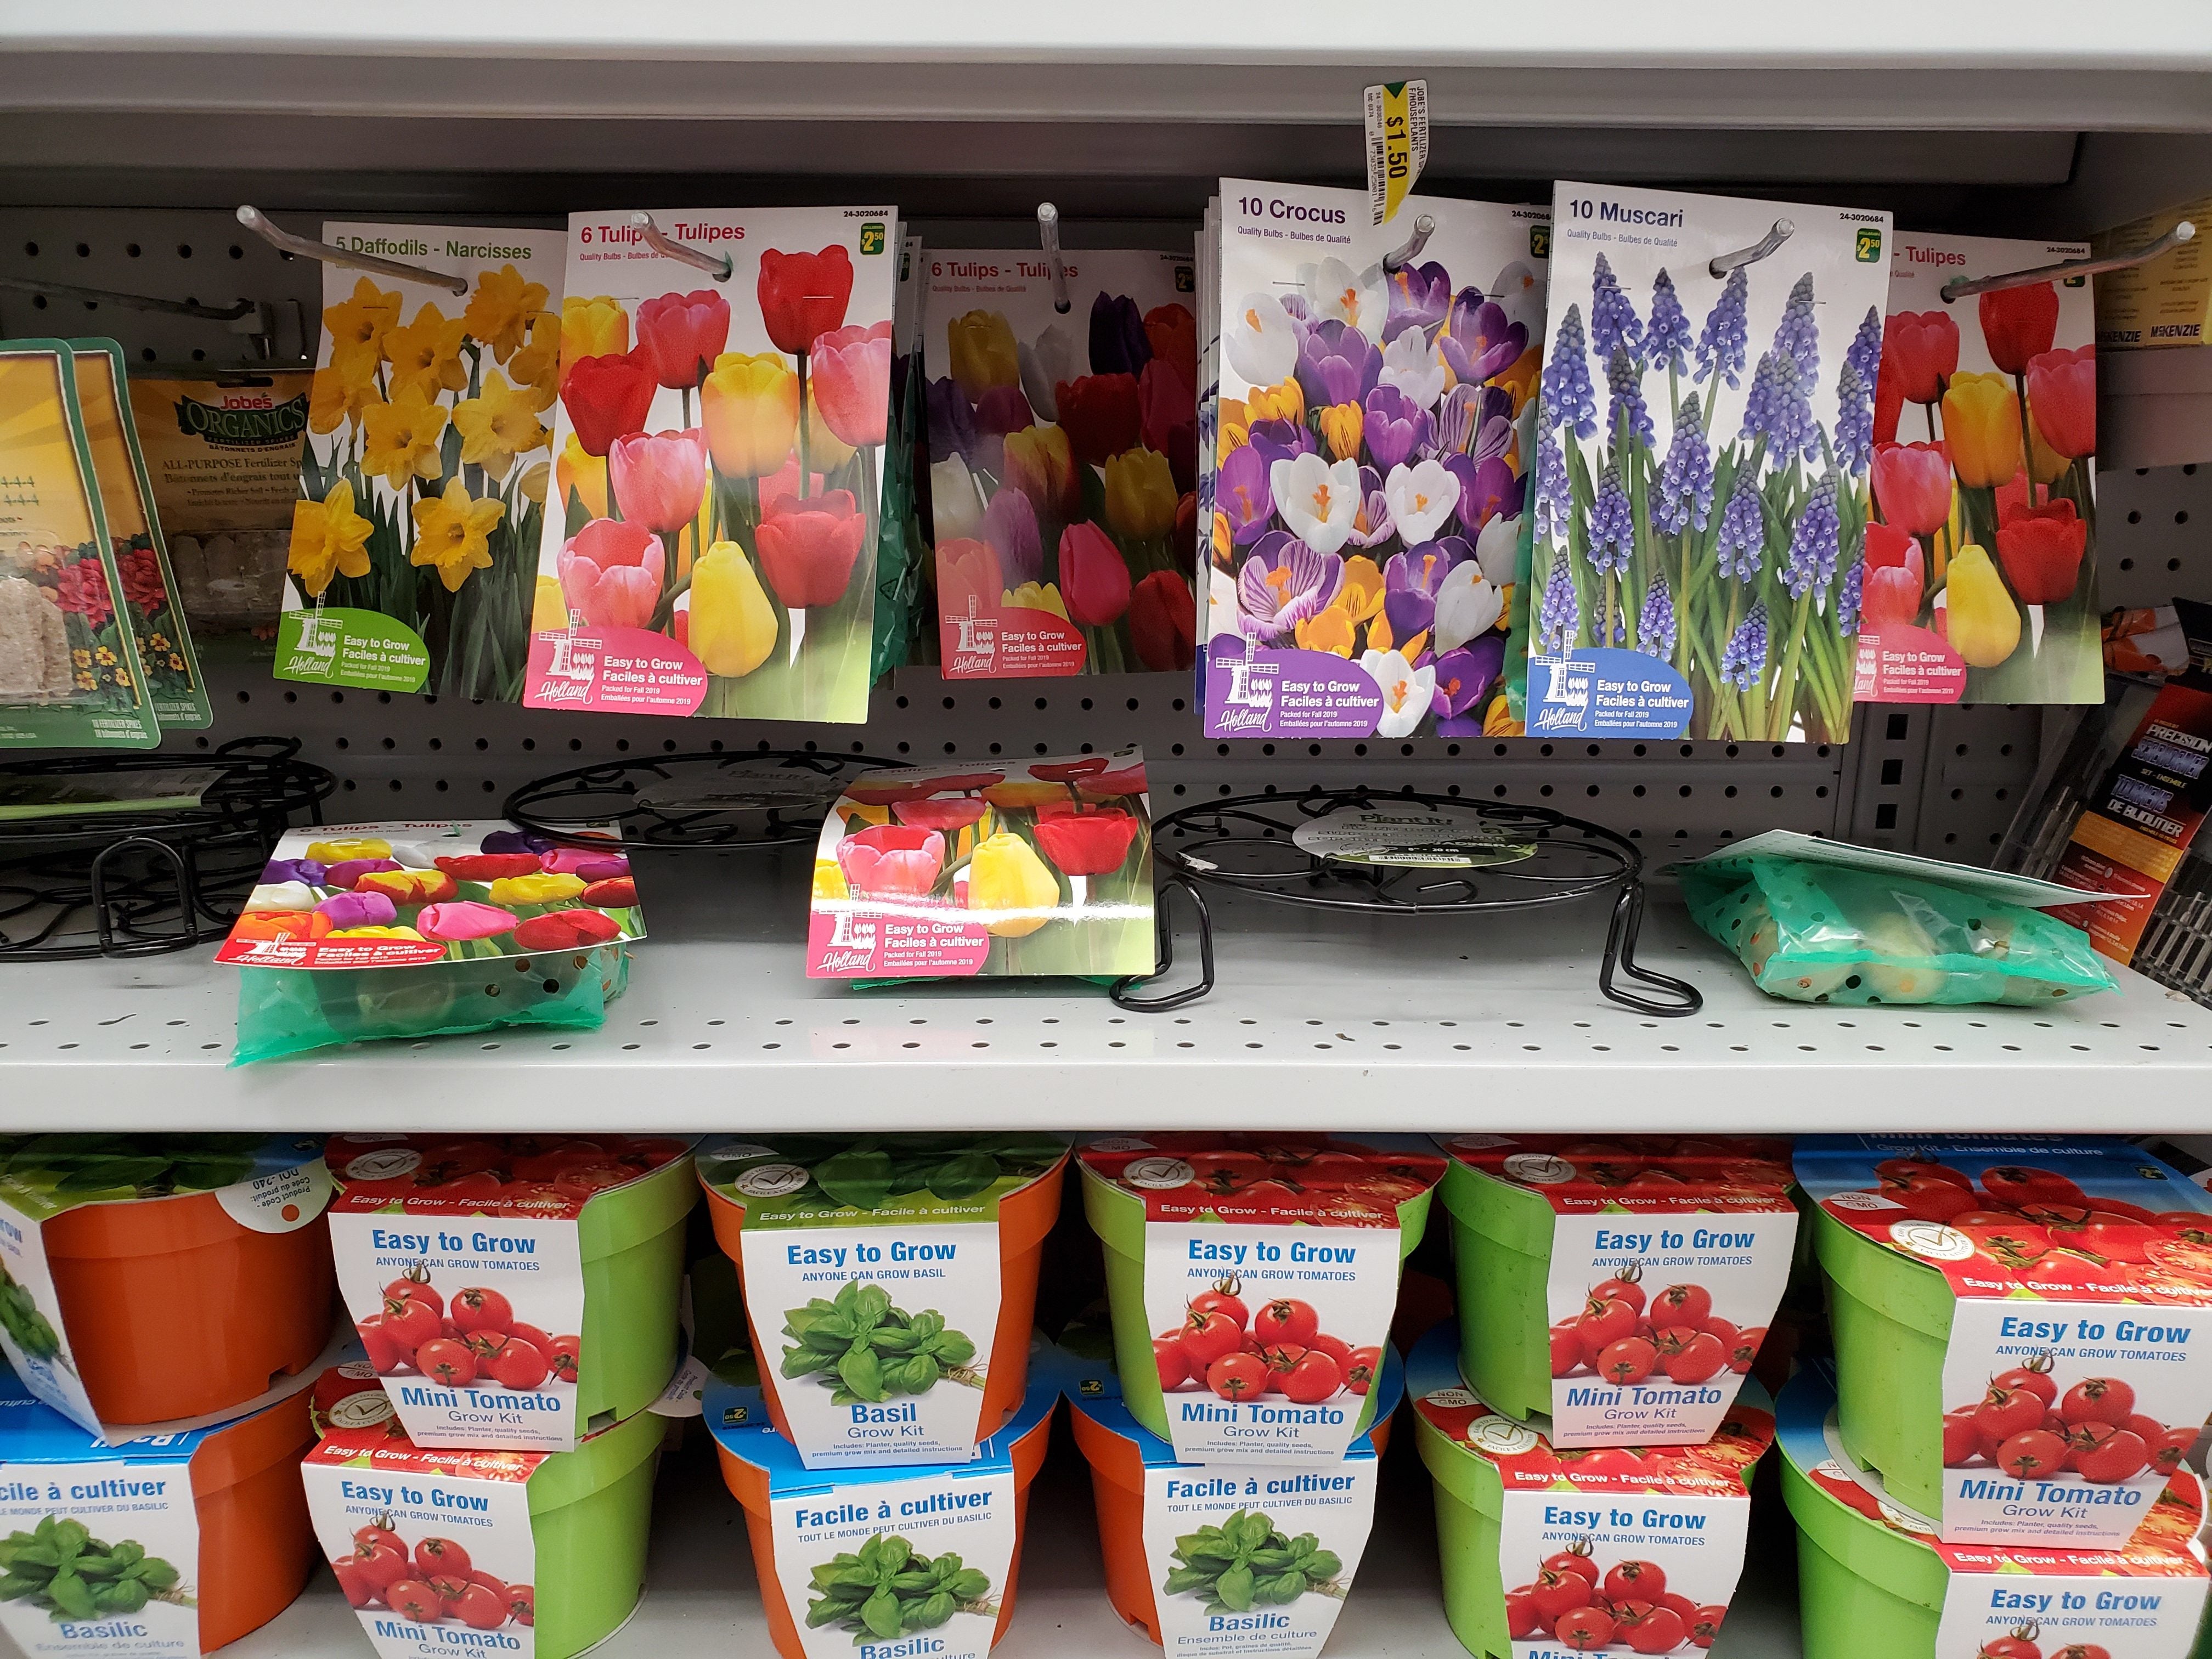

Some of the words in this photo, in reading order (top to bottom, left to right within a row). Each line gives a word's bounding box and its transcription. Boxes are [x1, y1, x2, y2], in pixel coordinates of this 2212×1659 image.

[1417, 86, 1425, 114] JOBE'S
[1408, 88, 1419, 151] F/HOUSEPLANTS
[1385, 116, 1408, 178] $1.50
[1418, 116, 1426, 160] FERTILIZER
[1239, 197, 1262, 216] 10
[1269, 199, 1346, 224] Crocus
[1570, 200, 1592, 219] 10
[1600, 201, 1683, 228] Muscari
[1839, 212, 1884, 223] 24-3020684
[580, 227, 592, 244] 6
[675, 223, 746, 242] Tulipes
[1238, 225, 1261, 238] Quality
[1263, 229, 1283, 239] Bulbs
[1290, 231, 1313, 241] Bulbes
[1316, 233, 1324, 241] de
[1326, 233, 1351, 244] Qualité
[351, 236, 428, 256] Daffodils
[446, 240, 532, 259] Narcisses
[1905, 245, 1966, 267] Tulipes
[932, 262, 942, 276] 6
[947, 262, 999, 280] Tulips
[186, 397, 306, 438] ORGANICS
[343, 635, 368, 647] Easy
[370, 637, 380, 648] to
[382, 639, 410, 651] Grow
[1001, 631, 1024, 642] Easy
[1026, 631, 1037, 640] to
[1039, 630, 1065, 640] Grow
[342, 648, 378, 661] Faciles
[380, 651, 386, 662] à
[388, 654, 426, 666] cultiver
[1002, 644, 1036, 653] Faciles
[1038, 643, 1044, 652] à
[1047, 642, 1082, 651] cultiver
[283, 656, 334, 679] Holland
[603, 656, 633, 670] Easy
[635, 657, 648, 669] to
[651, 657, 684, 670] Grow
[602, 670, 645, 683] Faciles
[648, 672, 656, 684] à
[658, 674, 703, 686] cultiver
[1282, 680, 1311, 695] Easy
[1312, 681, 1325, 692] to
[1328, 680, 1360, 692] Grow
[1597, 679, 1624, 693] Easy
[1627, 681, 1638, 691] to
[1641, 681, 1672, 693] Grow
[534, 681, 592, 704] Holland
[1280, 695, 1323, 707] Faciles
[1325, 695, 1333, 707] à
[1335, 695, 1380, 707] cultiver
[1596, 695, 1635, 707] Faciles
[1638, 695, 1645, 707] à
[1647, 695, 1689, 708] cultiver
[1215, 707, 1272, 732] Holland
[1533, 707, 1587, 731] Holland
[885, 923, 914, 936] Easy
[916, 924, 929, 934] to
[932, 923, 964, 934] Grow
[884, 937, 927, 948] Faciles
[929, 936, 937, 947] à
[940, 936, 984, 947] cultiver
[816, 951, 876, 972] Holland
[1840, 1193, 1871, 1201] NON
[1846, 1201, 1878, 1210] GMO
[372, 1229, 430, 1255] Easy
[438, 1232, 463, 1252] to
[472, 1232, 535, 1254] Grow
[1594, 1230, 1653, 1254] Easy
[1661, 1230, 1684, 1250] to
[1692, 1228, 1755, 1250] Grow
[787, 1244, 847, 1267] Easy
[856, 1243, 881, 1263] to
[891, 1242, 957, 1263] Grow
[1188, 1239, 1248, 1265] Easy
[1256, 1241, 1281, 1262] to
[1290, 1241, 1356, 1263] Grow
[802, 1270, 848, 1282] ANYONE
[850, 1269, 873, 1280] CAN
[877, 1269, 910, 1279] GROW
[913, 1268, 946, 1278] BASIL
[1237, 1269, 1258, 1279] CAN
[1261, 1269, 1294, 1280] GROW
[1297, 1270, 1356, 1282] TOMATOES
[2000, 1317, 2068, 1344] Easy
[2078, 1319, 2105, 1340] to
[2115, 1320, 2192, 1344] Grow
[401, 1386, 459, 1409] Mini
[464, 1389, 561, 1412] Tomato
[1566, 1386, 1621, 1407] Mini
[1631, 1386, 1723, 1406] Tomato
[851, 1403, 917, 1424] Basil
[1181, 1403, 1238, 1423] Mini
[1248, 1404, 1345, 1425] Tomato
[847, 1426, 895, 1439] Grow
[900, 1425, 924, 1437] Kit
[866, 1441, 892, 1449] Planter,
[893, 1440, 917, 1448] quality
[47, 1482, 61, 1500] à
[71, 1480, 166, 1500] cultiver
[1167, 1479, 1237, 1499] Facile
[1244, 1477, 1259, 1496] à
[1267, 1474, 1355, 1494] cultiver
[1959, 1479, 2024, 1504] Mini
[2035, 1482, 2142, 1507] Tomato
[795, 1507, 870, 1528] Facile
[878, 1500, 891, 1519] à
[900, 1490, 992, 1516] cultiver
[798, 1533, 821, 1543] TOUT
[824, 1532, 836, 1541] LE
[837, 1526, 871, 1539] MONDE
[873, 1524, 895, 1534] PEUT
[898, 1519, 940, 1532] CULTIVER
[943, 1516, 955, 1526] DU
[957, 1512, 992, 1524] BASILIC
[1990, 1588, 2053, 1613] Easy
[2061, 1590, 2086, 1610] to
[2095, 1590, 2163, 1611] Grow
[61, 1621, 148, 1639] Basilic
[1209, 1613, 1290, 1633] Basilic
[1177, 1633, 1245, 1645] Ensemble
[1249, 1633, 1266, 1641] de
[1270, 1629, 1317, 1640] culture
